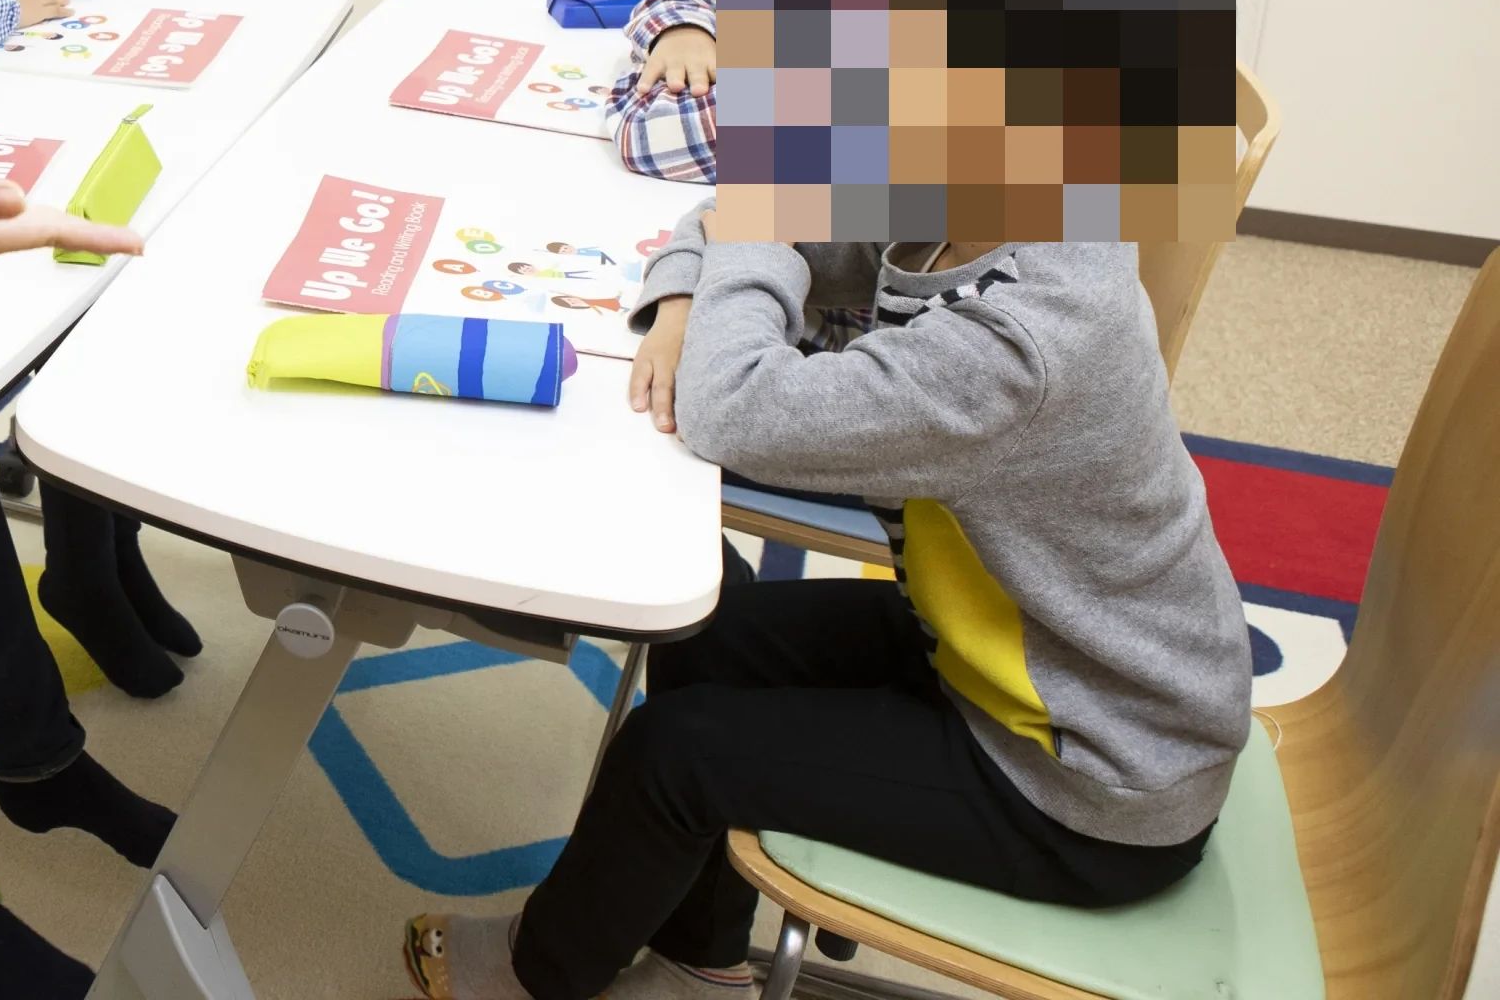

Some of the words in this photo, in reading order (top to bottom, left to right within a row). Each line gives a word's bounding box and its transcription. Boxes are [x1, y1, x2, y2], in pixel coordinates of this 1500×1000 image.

[418, 81, 473, 106] Up
[457, 37, 505, 66] Go!
[338, 189, 396, 234] Go!
[405, 200, 429, 228] Book
[394, 219, 425, 253] Writing
[473, 243, 497, 252] D
[318, 238, 376, 268] We
[442, 263, 465, 273] A
[300, 270, 369, 301] Up
[372, 263, 405, 296] Reading
[468, 288, 494, 299] B
[492, 281, 516, 291] C
